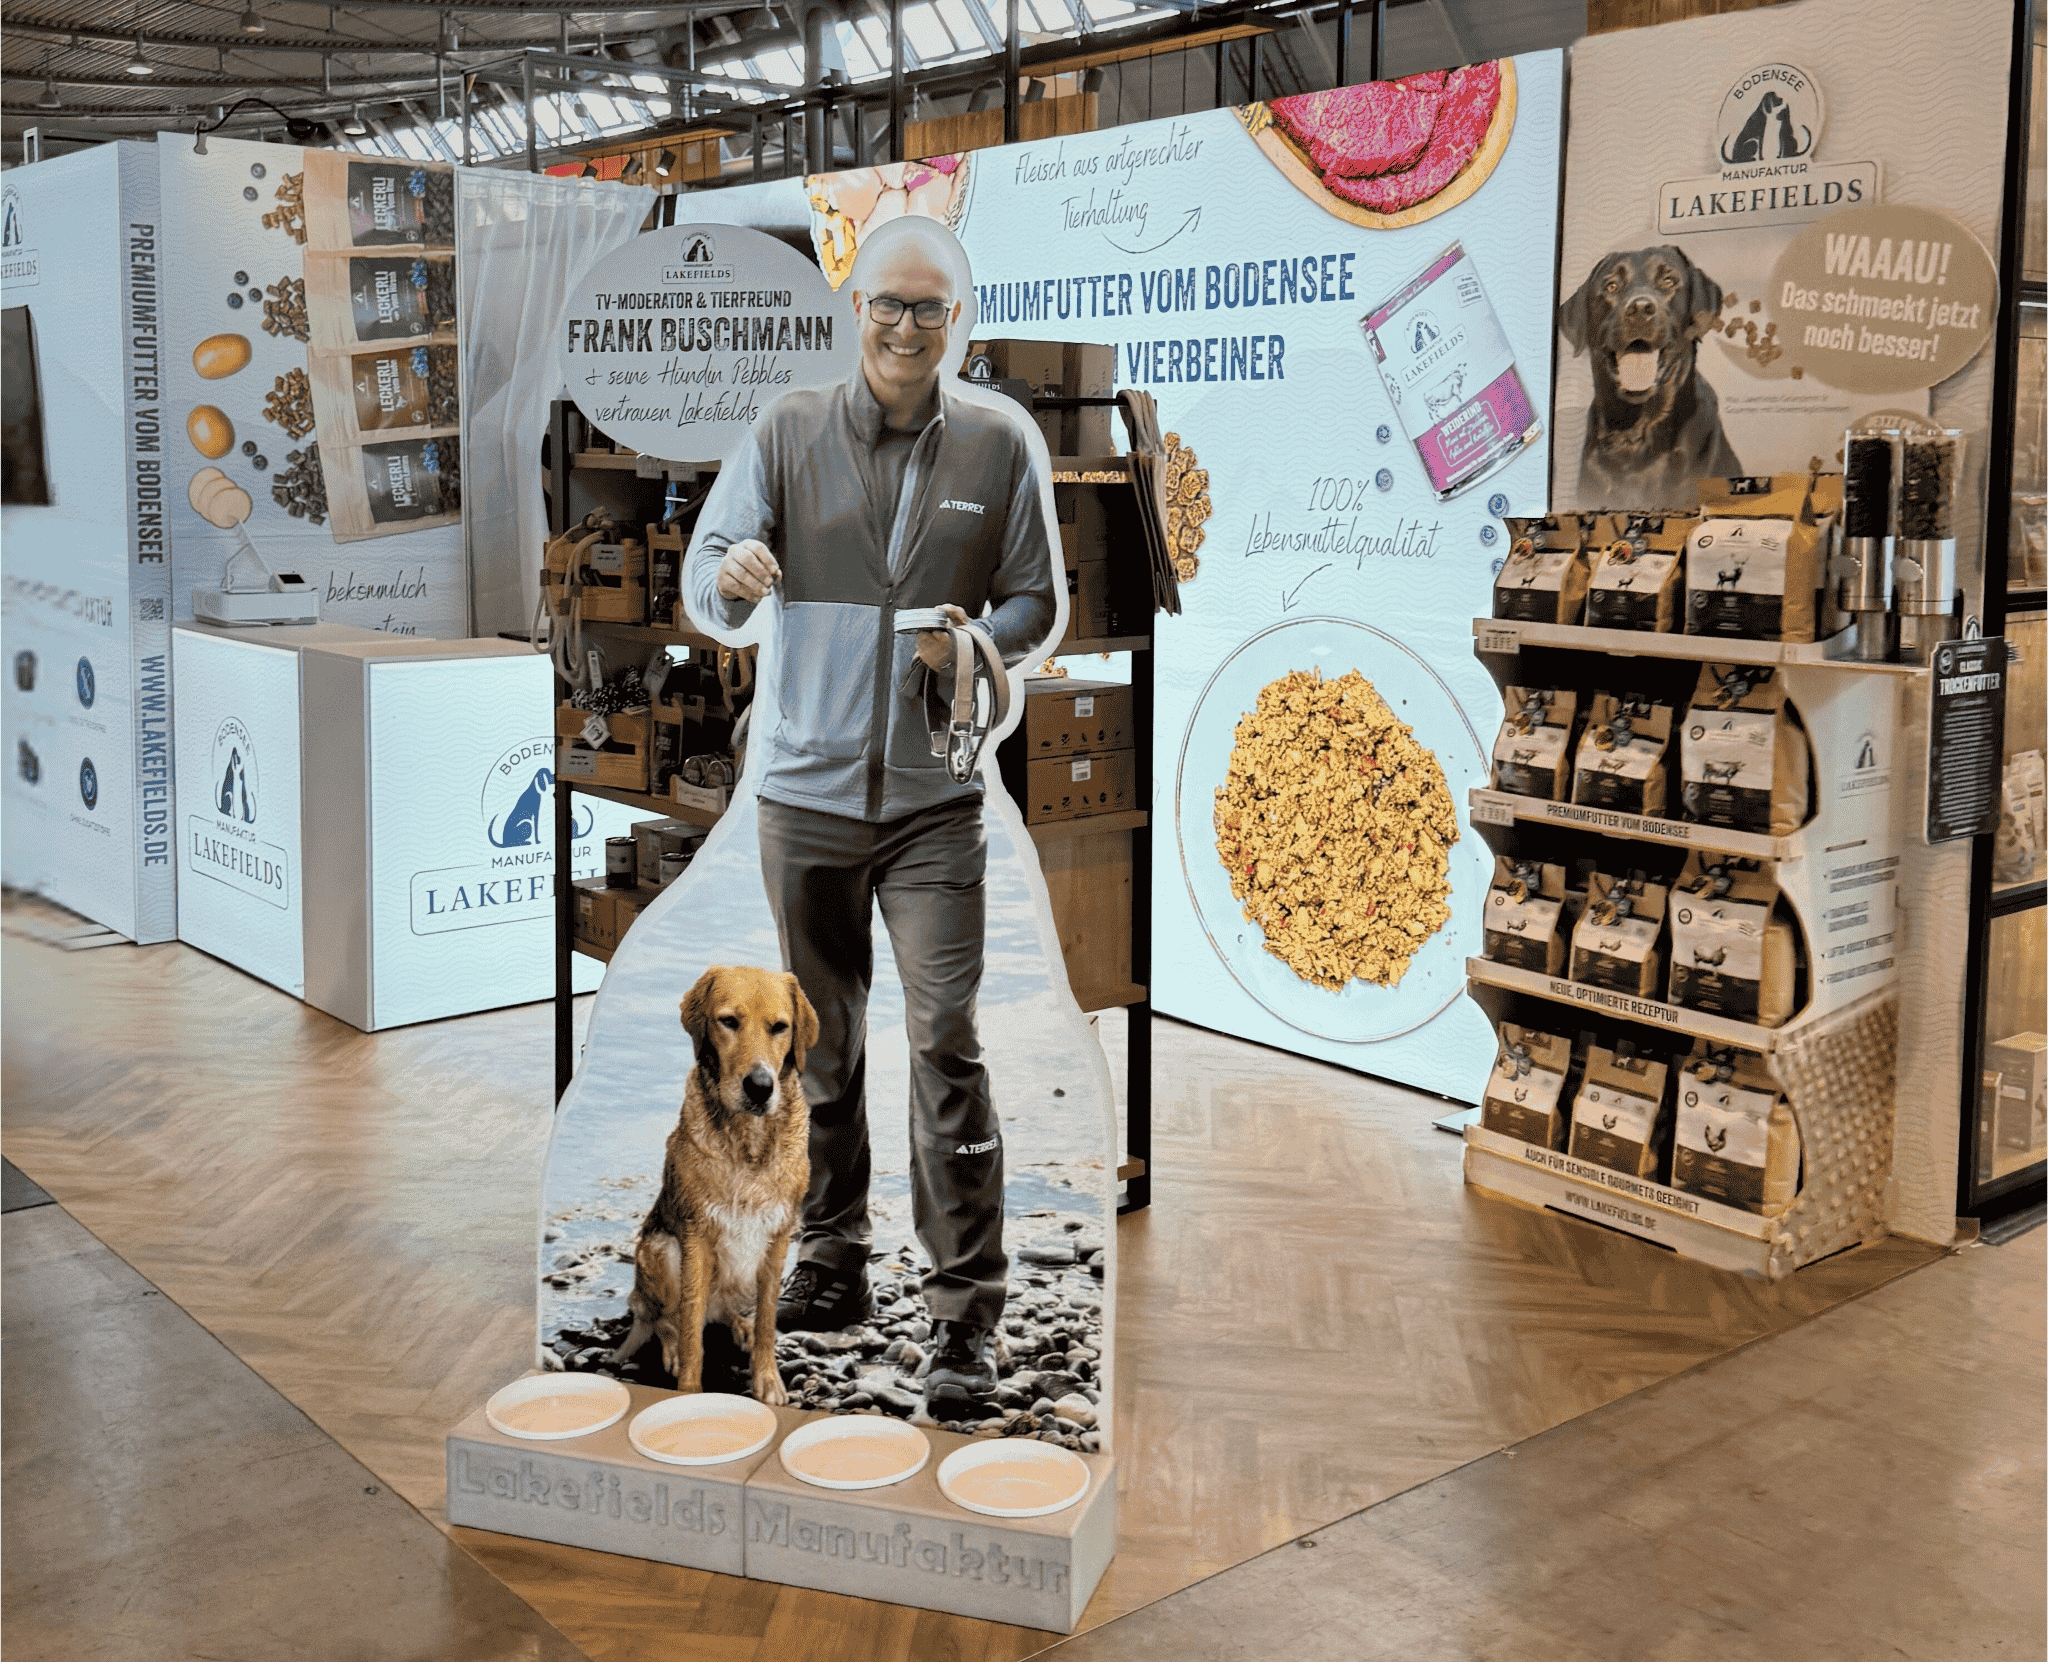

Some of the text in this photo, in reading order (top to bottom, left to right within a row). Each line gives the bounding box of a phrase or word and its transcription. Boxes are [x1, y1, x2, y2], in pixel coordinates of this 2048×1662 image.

[1733, 69, 1804, 100] BODENSEE
[1013, 121, 1204, 186] Fleisch aus artgerechter
[1722, 163, 1808, 181] MANUFAKTUR
[373, 177, 388, 230] LECKERLI
[1060, 187, 1149, 237] Tierhaltung
[1669, 178, 1864, 219] LAKEFIELDS
[666, 270, 731, 279] LAKEFIELDS
[1824, 233, 1951, 286] WAAAU!
[374, 271, 392, 323] LECKERLI
[595, 290, 792, 311] TV-MODERATOR & TIERFREUND
[973, 273, 1132, 325] MIUMFUTTER
[1140, 267, 1197, 314] VOM
[1205, 252, 1356, 310] BODENSEE
[1781, 281, 1980, 330] Das schmeckt jetzt
[568, 315, 834, 353] FRANK BUSCHMANN
[1803, 322, 1940, 362] noch besser!
[607, 370, 651, 386] seine
[657, 353, 723, 388] Hündin
[731, 354, 794, 385] Pebbles
[1127, 334, 1286, 385] VIERBEINER
[130, 223, 164, 565] PREMIUMFUTTER VOM BODENSEE
[376, 359, 395, 412] LECKERLI
[595, 389, 759, 427] vertrauen Lakefields
[387, 455, 408, 508] LECKERLI
[1307, 477, 1370, 512] 100%
[950, 500, 985, 515] TERREX
[1245, 511, 1443, 570] Lebensmittelqualität
[140, 654, 169, 867] WWW.LAKEFIELDS.DE
[218, 722, 251, 757] BODENSEE
[499, 743, 556, 776] BODEN
[1546, 804, 1620, 827] PREMIUMFUTTER
[1642, 819, 1690, 838] BODENSEE
[194, 832, 283, 890] LAKEFIELDS
[491, 846, 592, 869] MANUFAUR
[1576, 987, 1629, 1012] OPTIMIERTE
[1631, 1001, 1678, 1023] REZEPTUR
[1525, 1148, 1547, 1166] AUCH
[1656, 1190, 1699, 1214] GEEIGNET
[455, 1449, 1070, 1595] Lakefields Manufaktur
